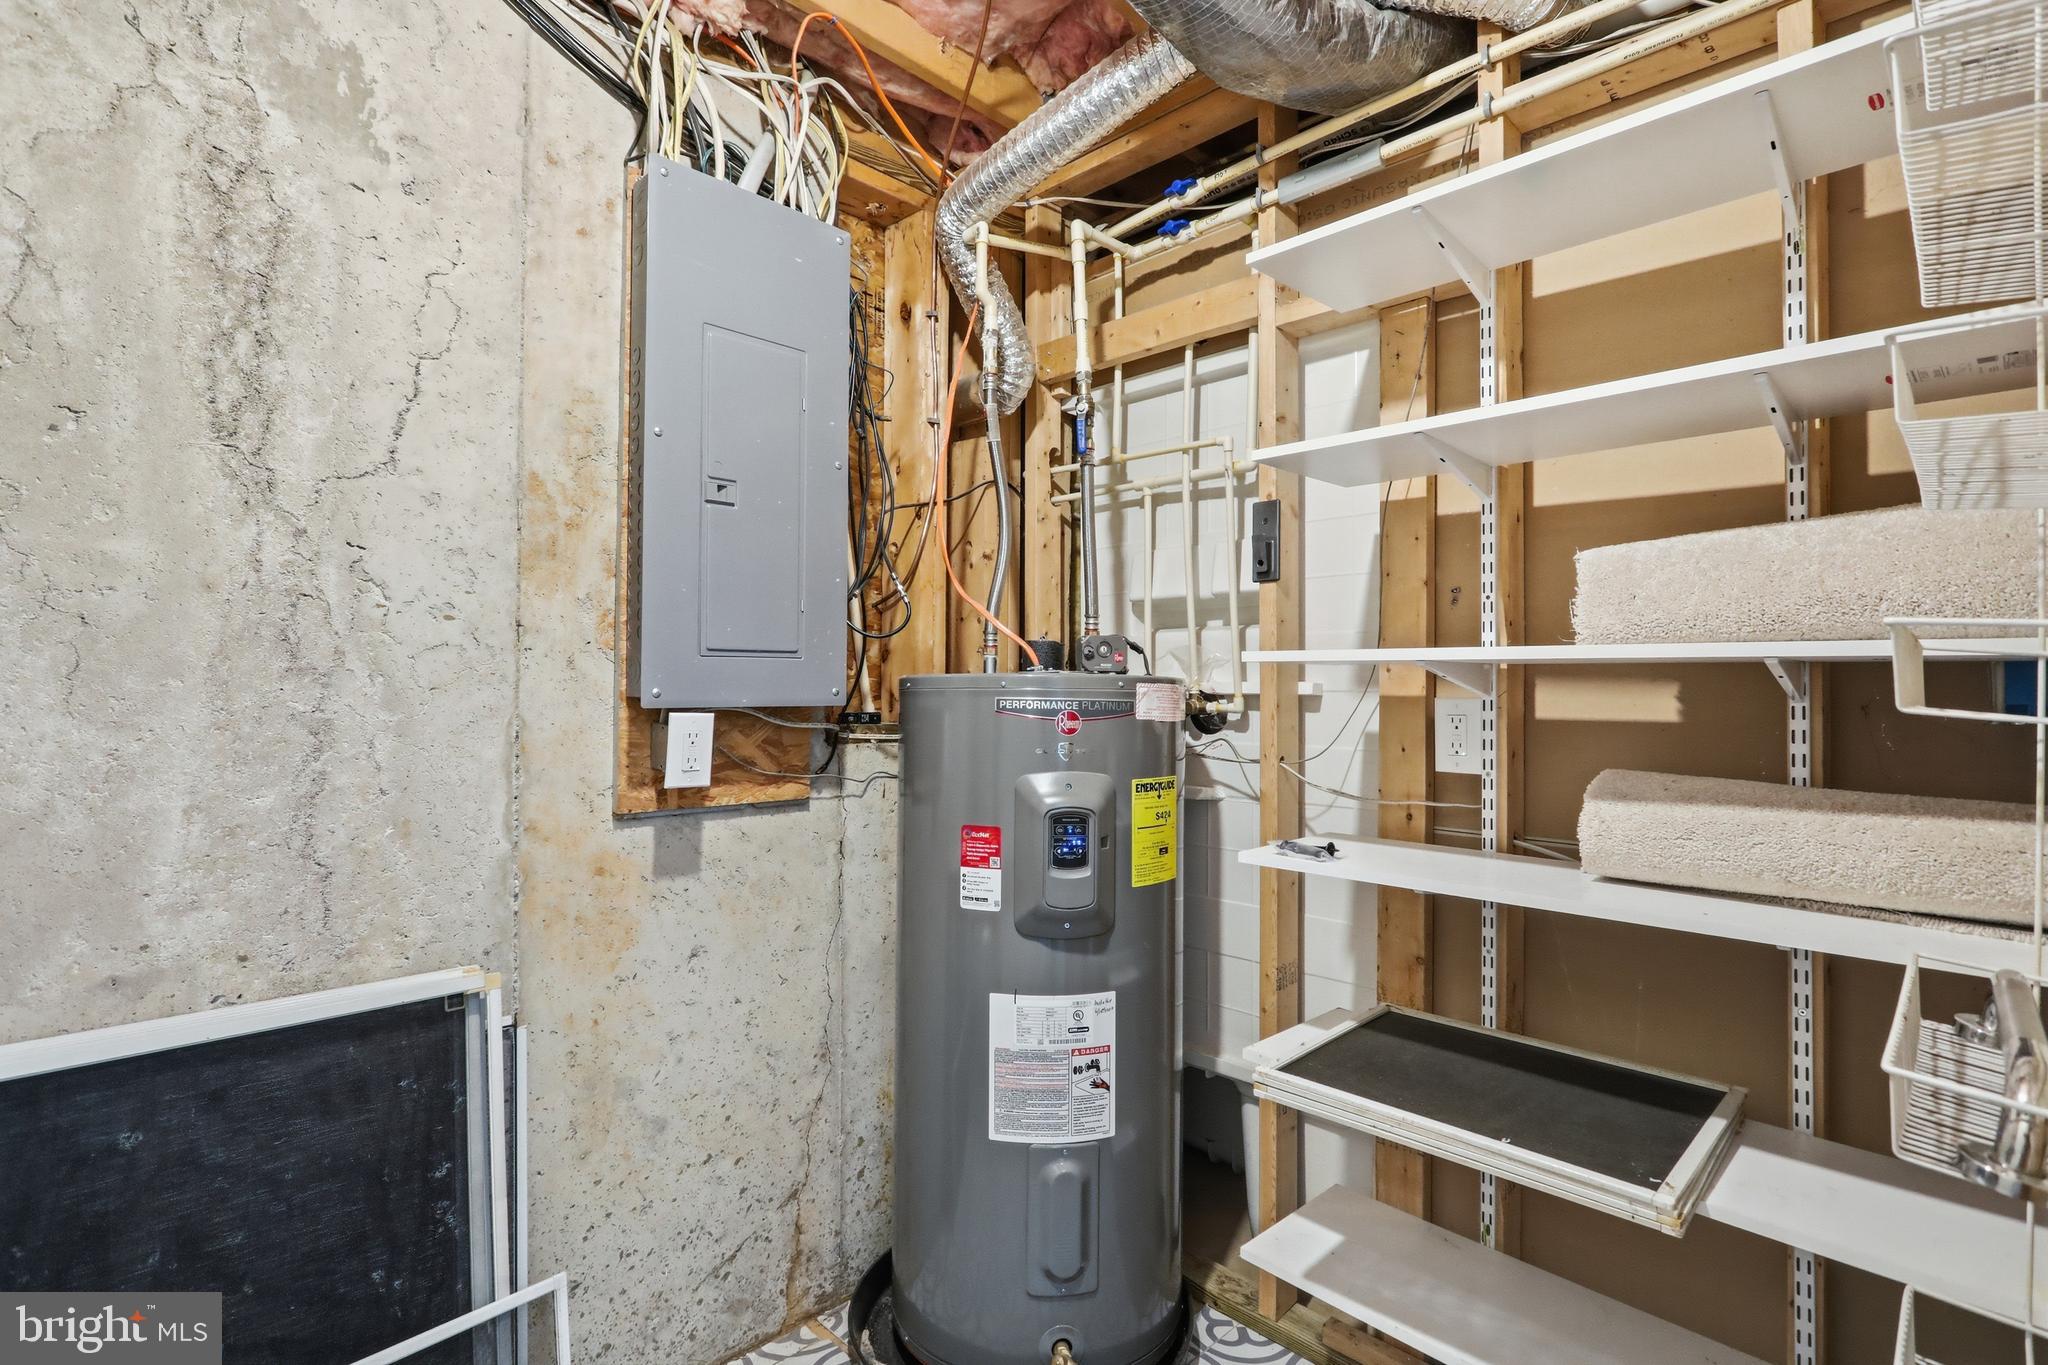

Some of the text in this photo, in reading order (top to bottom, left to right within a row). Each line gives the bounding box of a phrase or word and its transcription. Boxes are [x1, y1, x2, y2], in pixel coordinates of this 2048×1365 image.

[999, 700, 1131, 711] PERFORMANCE PLATINUM
[1080, 1046, 1109, 1055] DANGER
